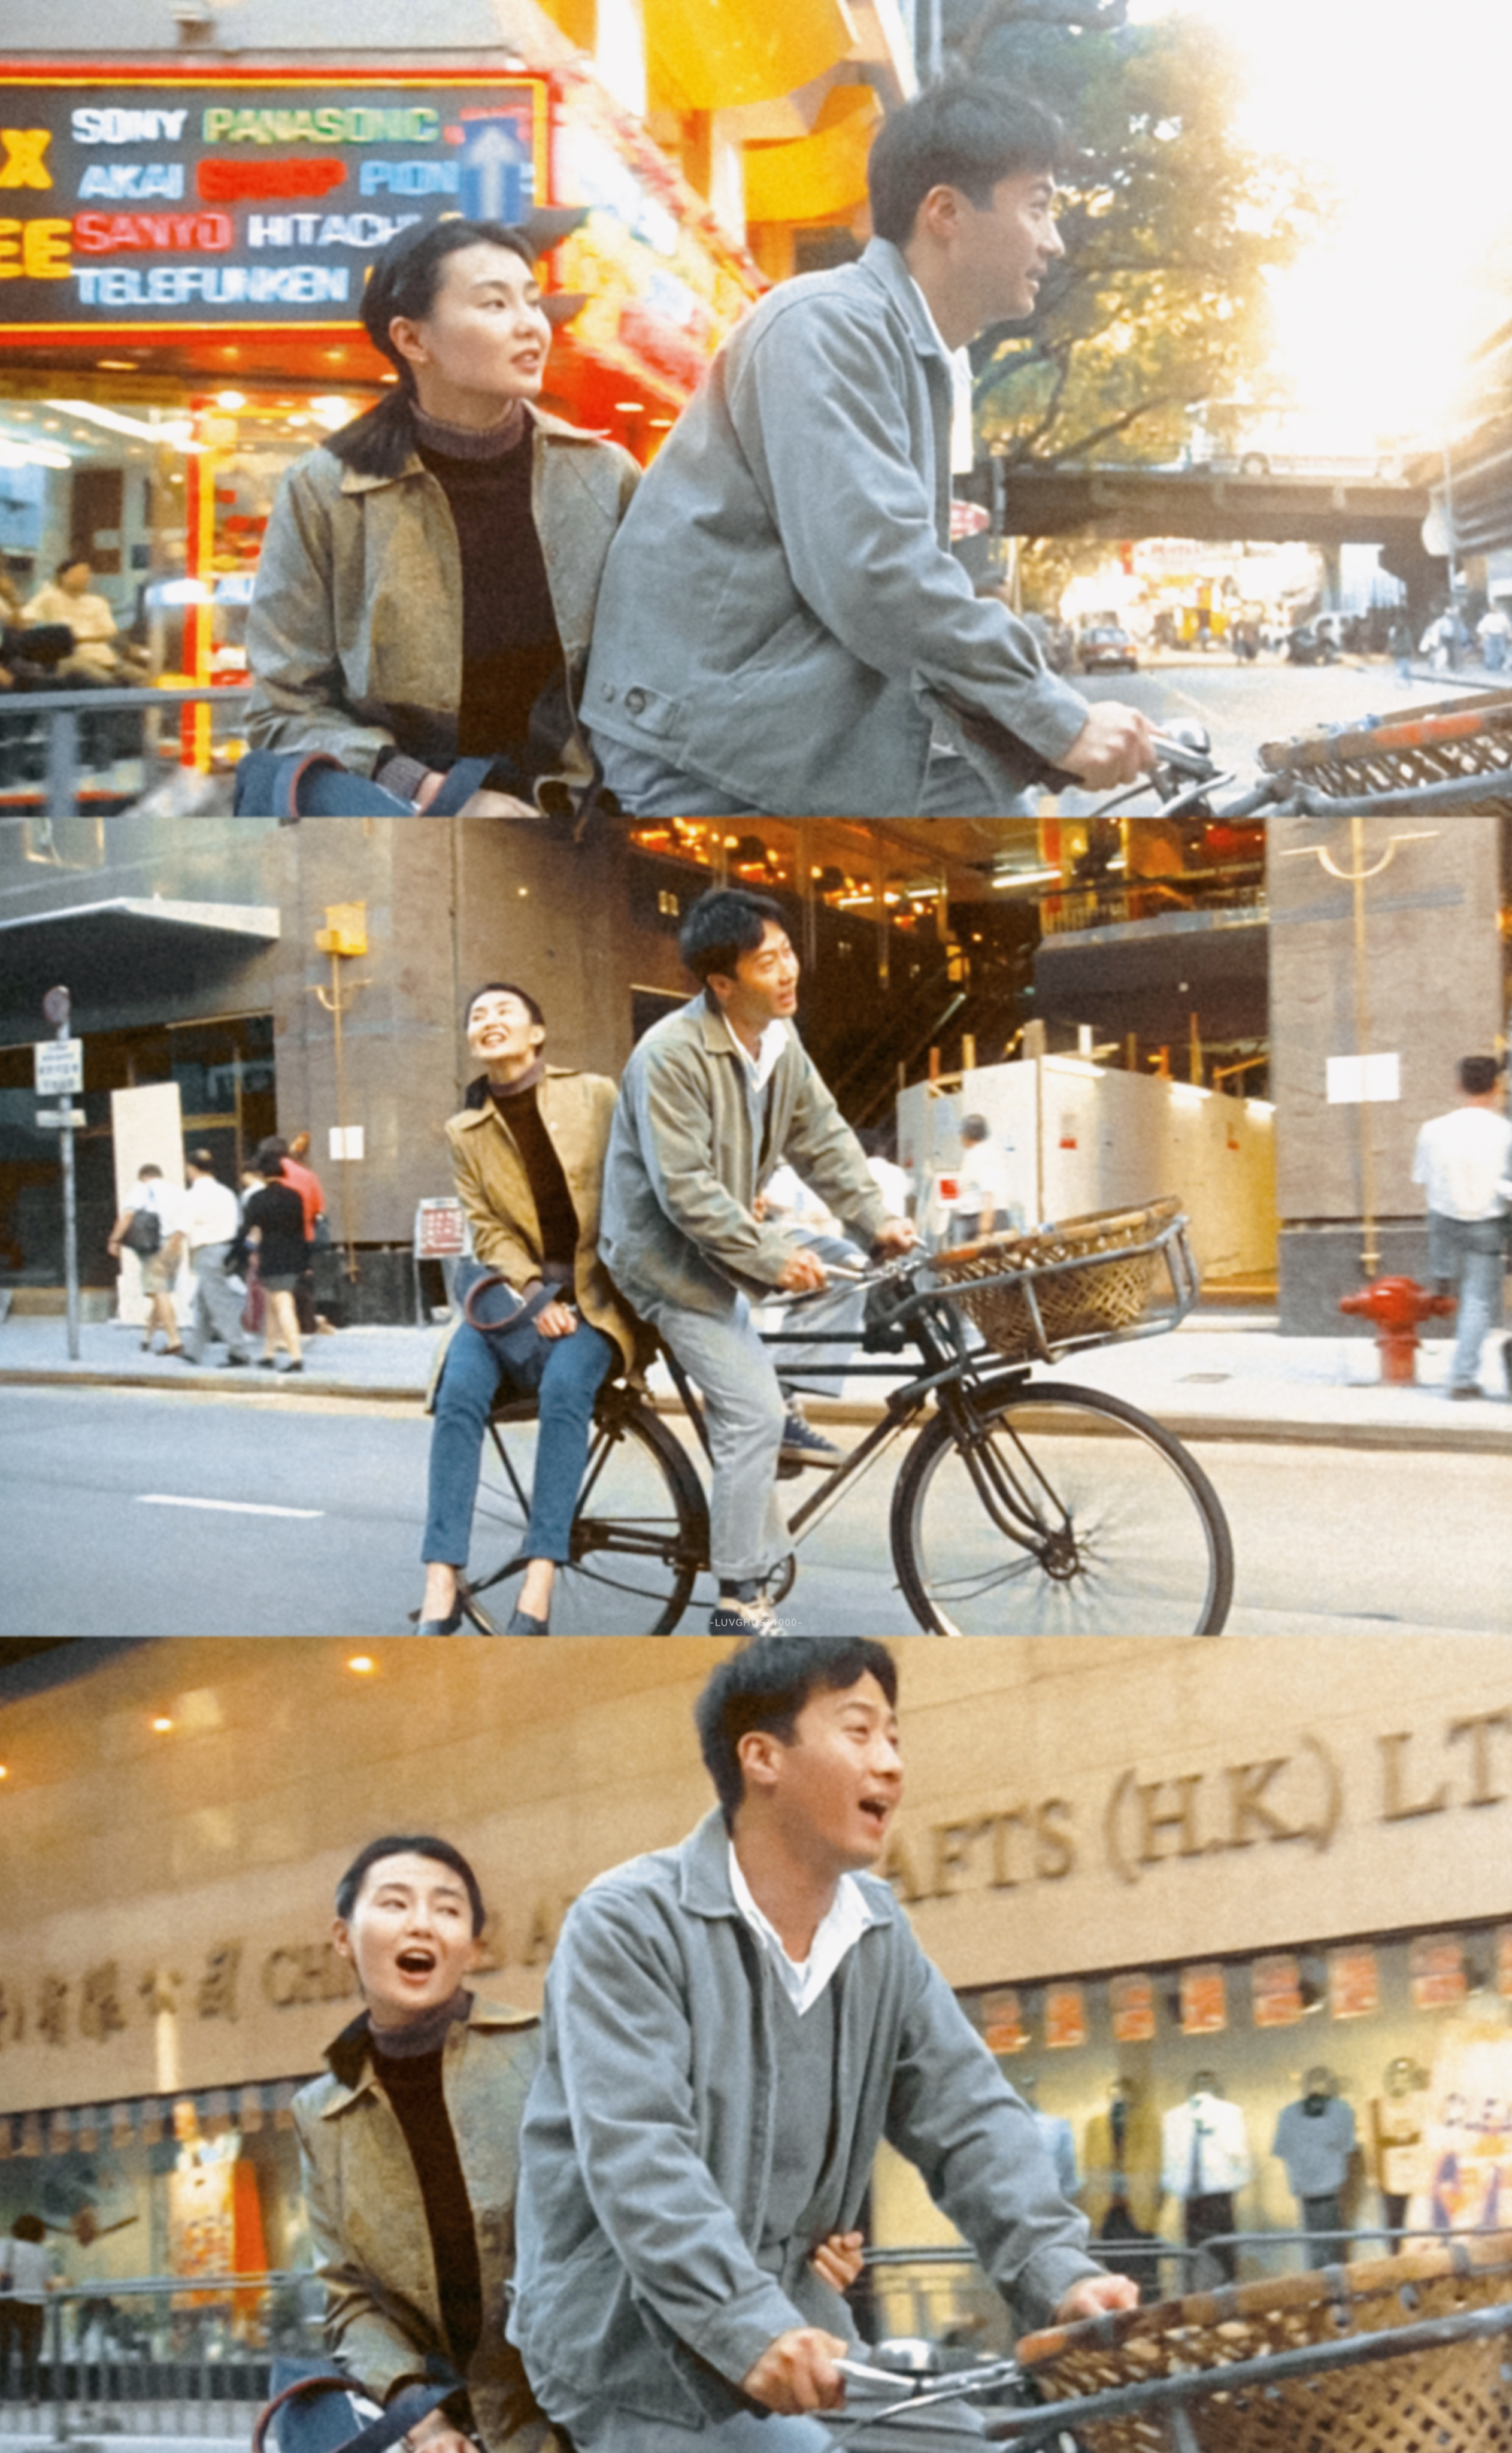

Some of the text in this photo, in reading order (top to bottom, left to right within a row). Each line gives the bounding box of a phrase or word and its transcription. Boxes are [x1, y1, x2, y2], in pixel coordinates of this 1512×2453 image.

[71, 108, 188, 144] SONY
[202, 107, 439, 144] PANASONIC
[77, 163, 185, 199] AKAI
[74, 212, 234, 253] SANYO
[71, 267, 350, 306] TELEFUNKEN
[884, 1797, 1077, 1903] AFTS
